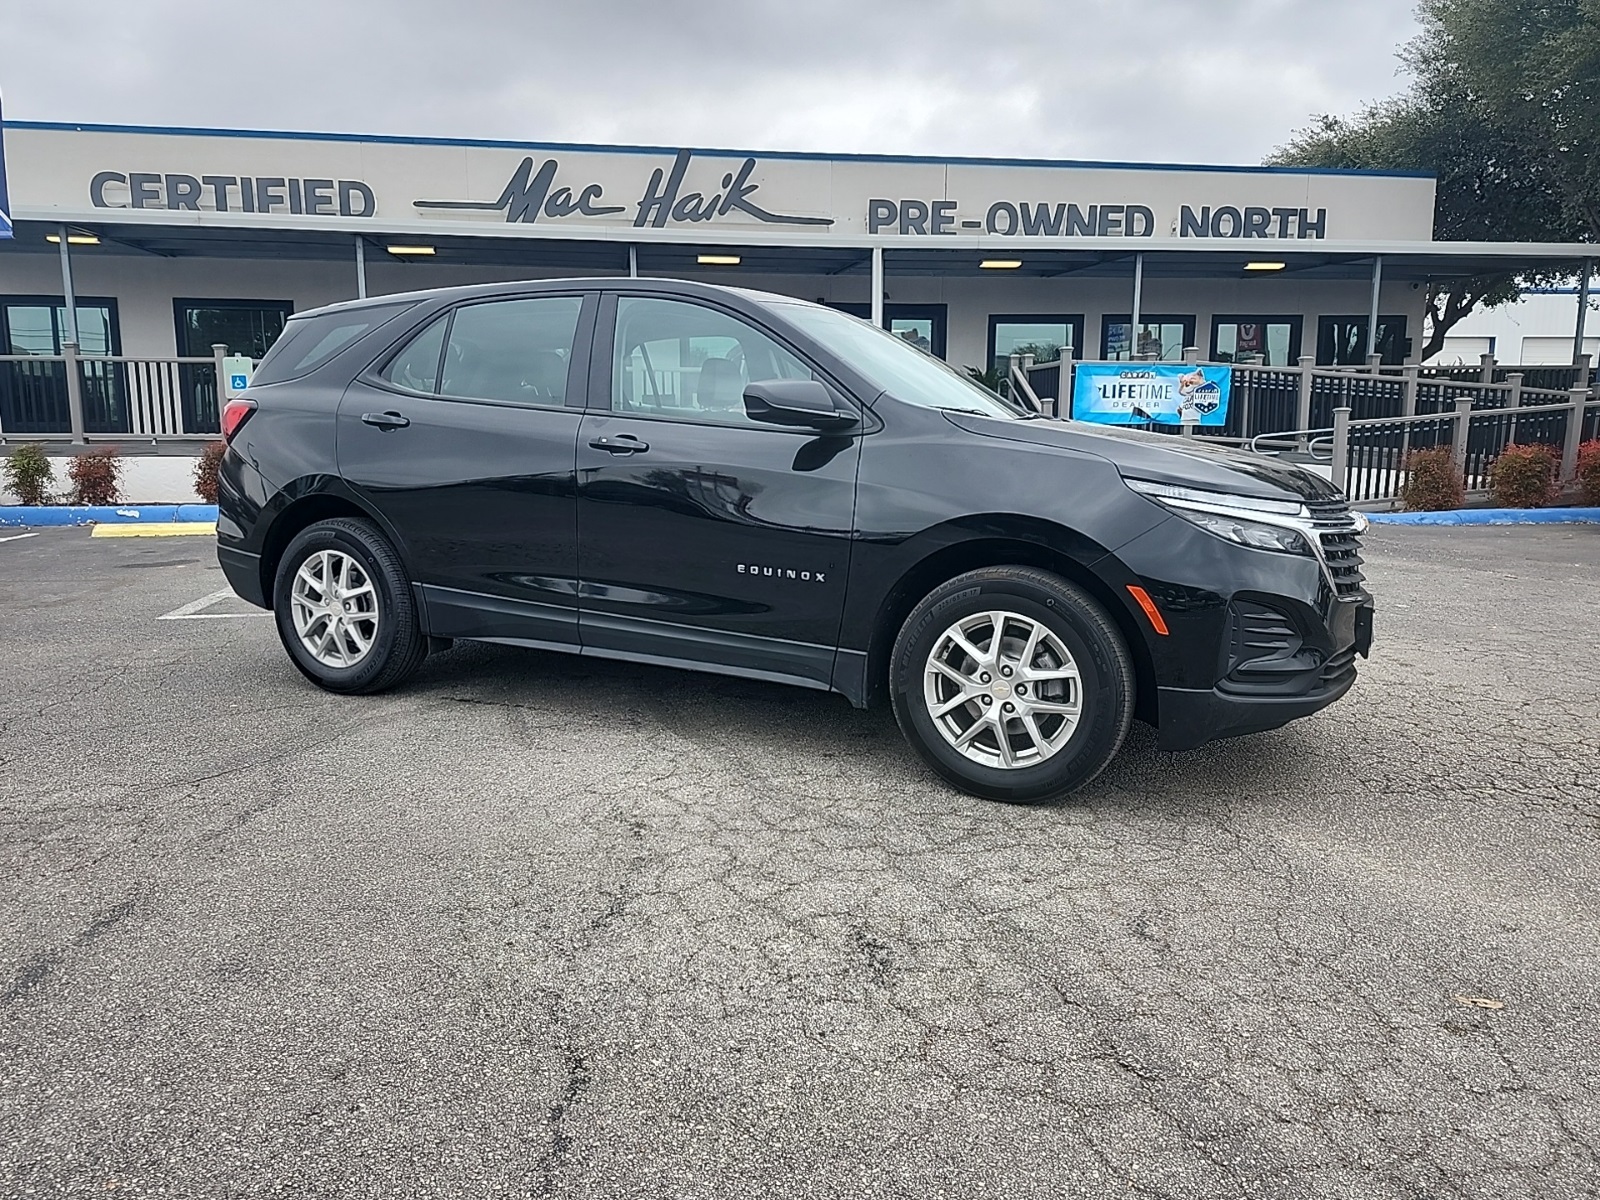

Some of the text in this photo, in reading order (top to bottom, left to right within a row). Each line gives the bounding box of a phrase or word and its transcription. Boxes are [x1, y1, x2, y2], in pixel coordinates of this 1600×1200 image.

[90, 149, 1327, 239] CERTIFIED Mac Haik PRE-OWNED NORTH
[1102, 384, 1173, 400] LIFETIME
[737, 564, 825, 582] EQUINOX
[902, 609, 935, 668] MICHELIN
